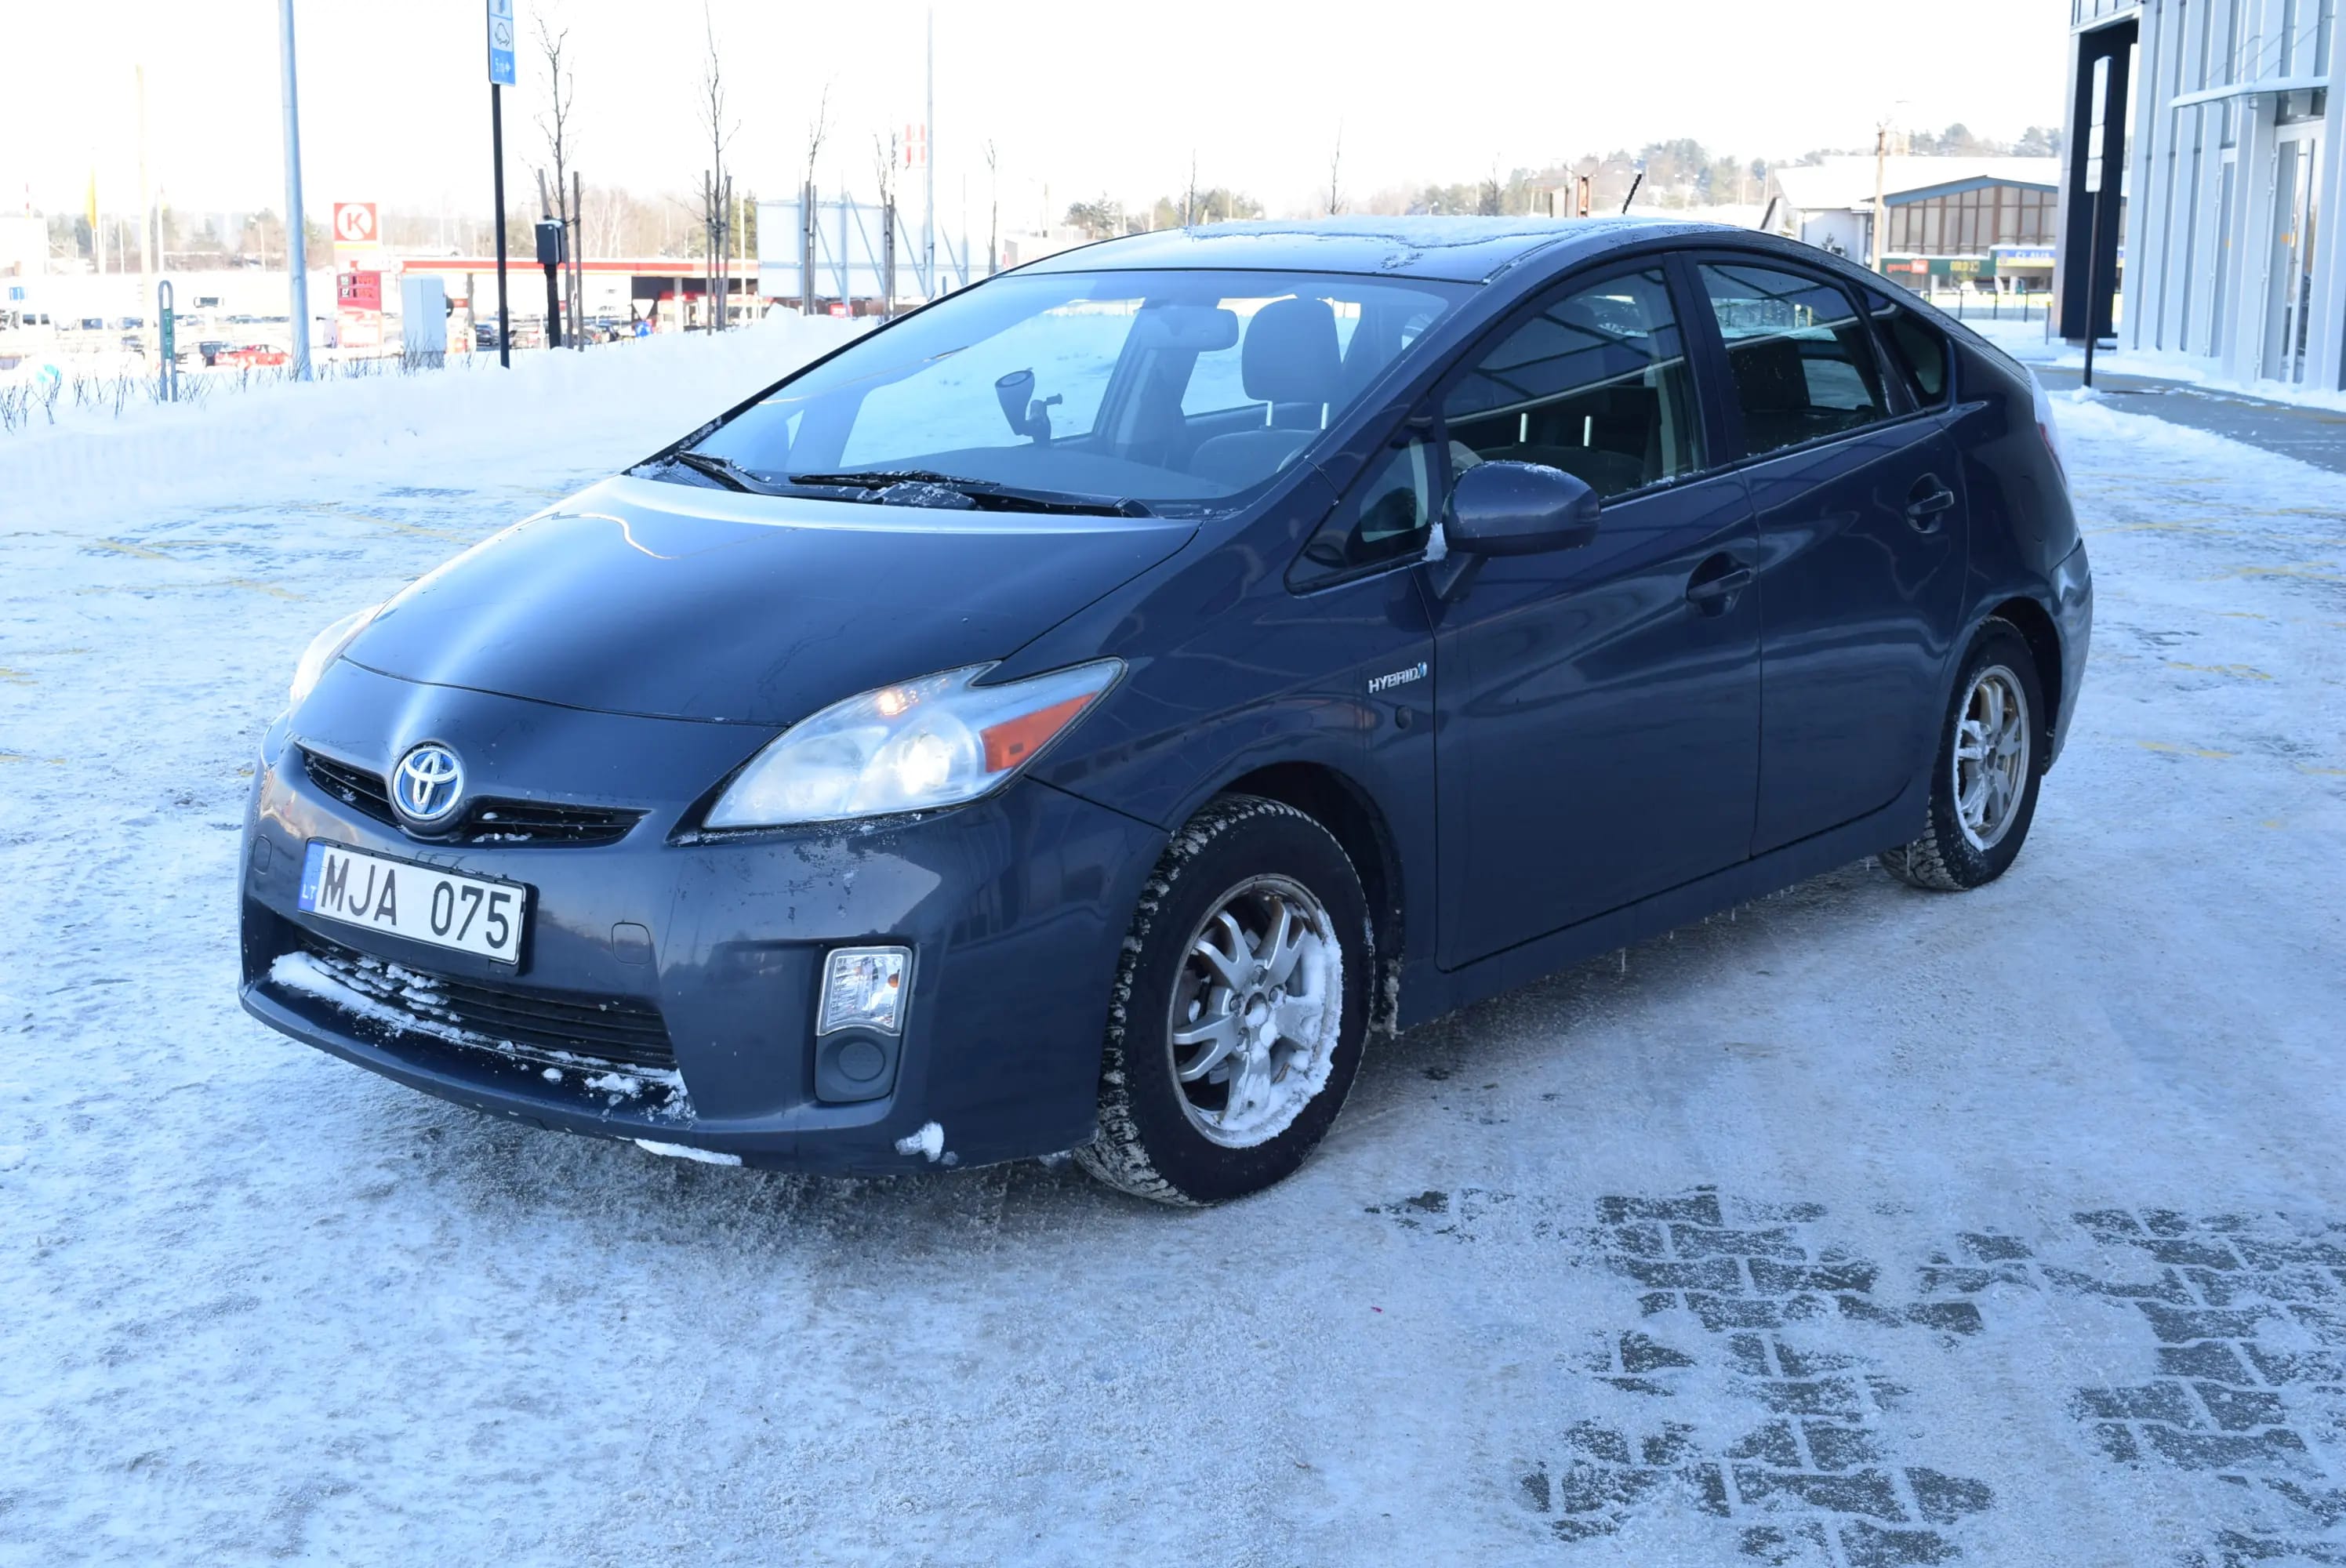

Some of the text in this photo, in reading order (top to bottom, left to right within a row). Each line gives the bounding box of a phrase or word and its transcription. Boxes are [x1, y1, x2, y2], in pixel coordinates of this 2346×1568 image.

[1368, 667, 1420, 694] HYBRID
[302, 884, 317, 900] LT
[321, 855, 512, 949] MJA 075
